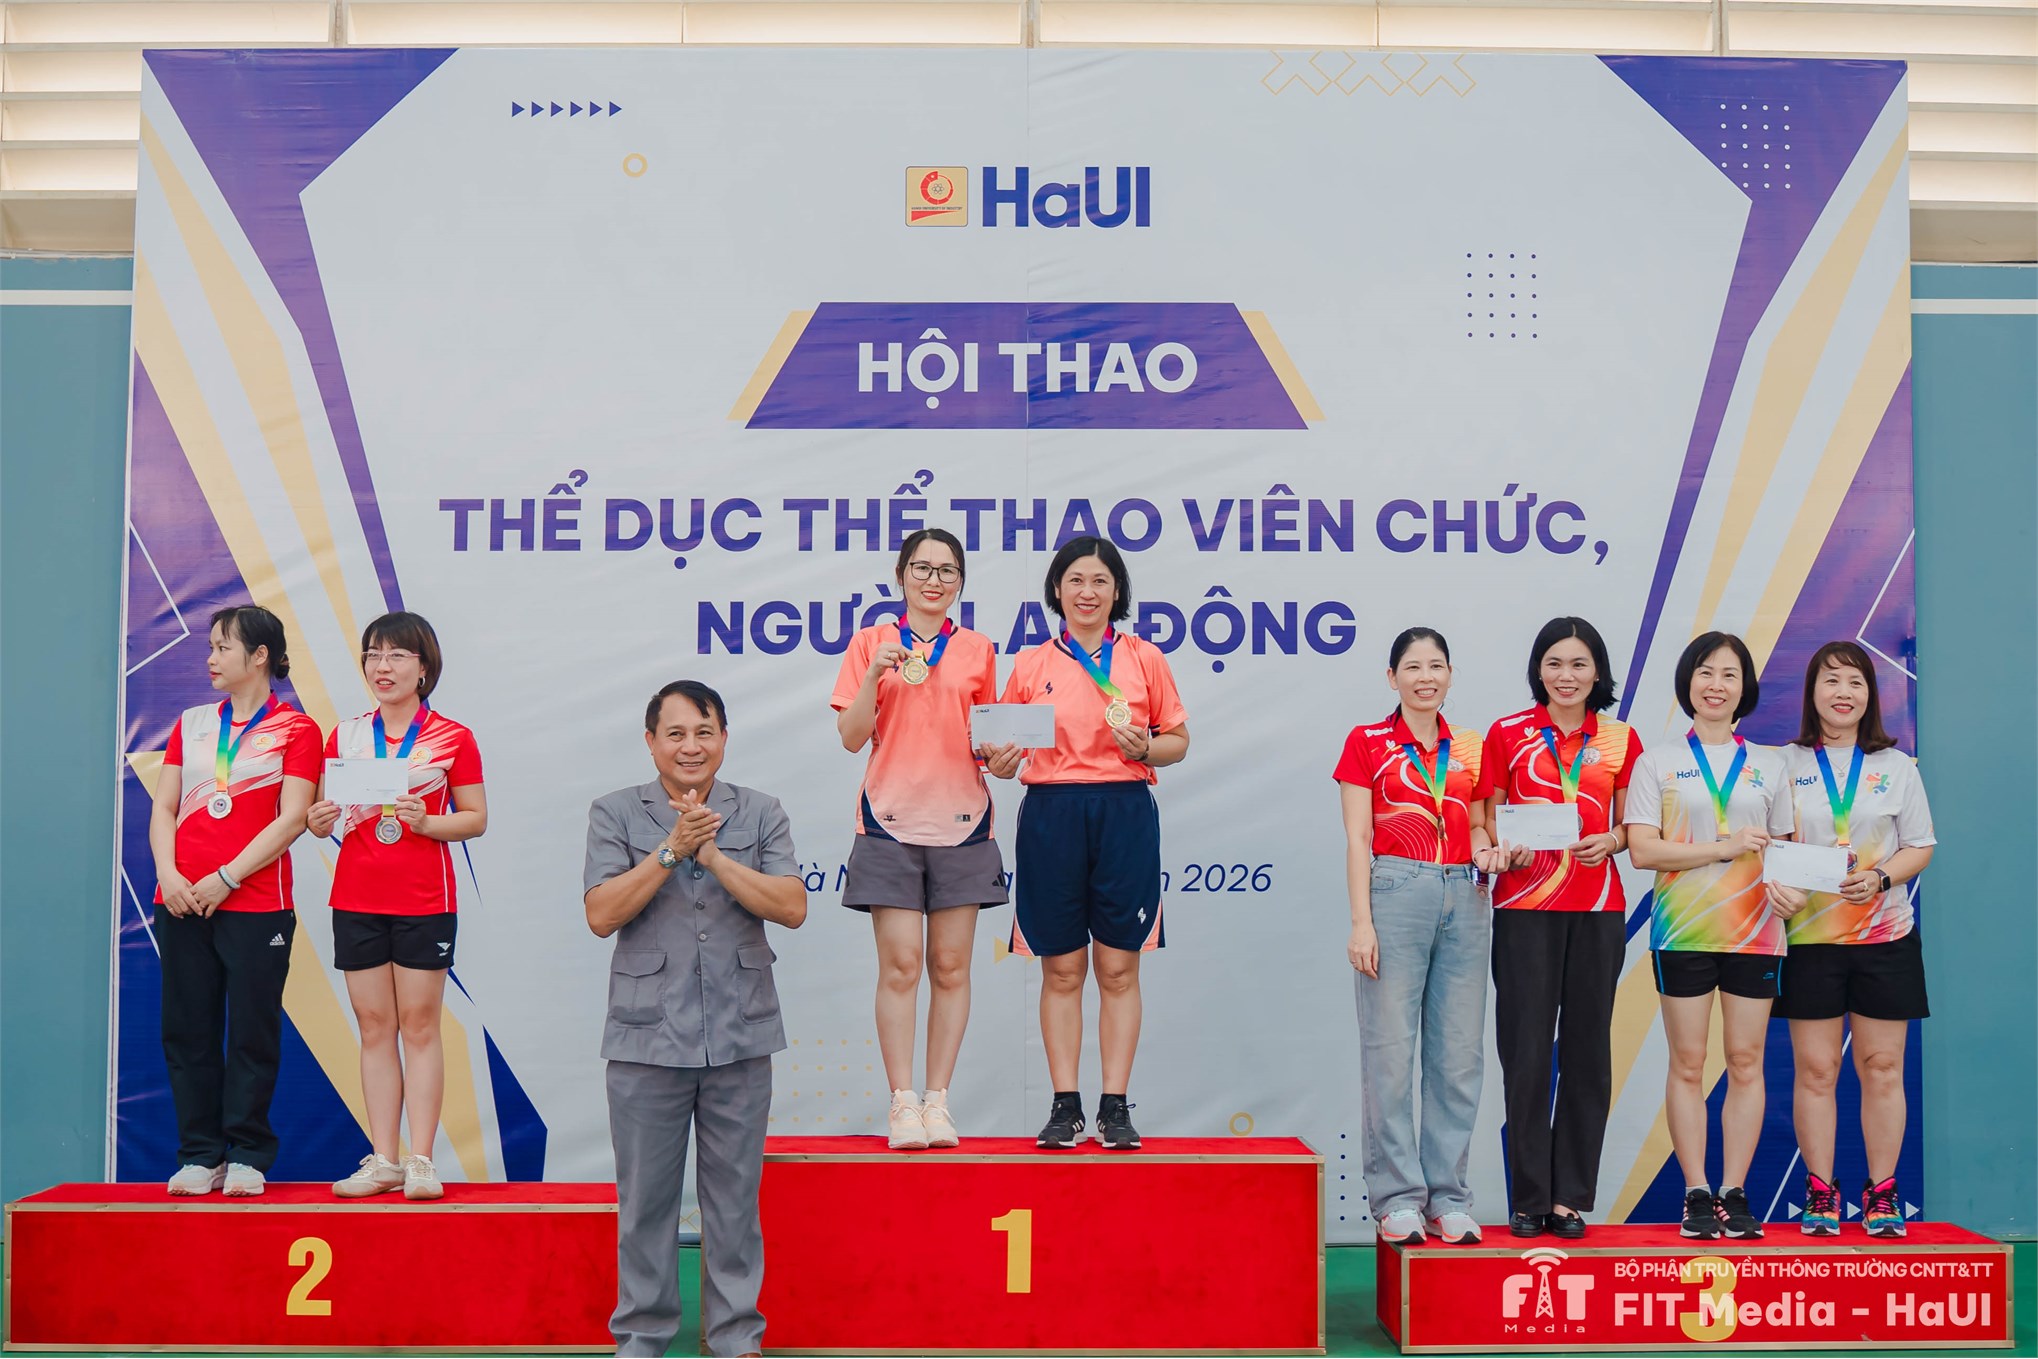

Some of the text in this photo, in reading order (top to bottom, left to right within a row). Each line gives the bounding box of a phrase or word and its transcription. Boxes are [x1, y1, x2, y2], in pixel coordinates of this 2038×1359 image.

[982, 166, 1151, 228] HaUI
[858, 327, 1198, 409] HỘI THAO
[439, 469, 1610, 570] THỂ DỤC THỂ THAO VIÊN CHỨC,
[961, 601, 1068, 655] LA
[1133, 585, 1357, 674] ĐỘNG
[1181, 863, 1273, 893] 2026
[286, 1236, 333, 1316] 2
[991, 1209, 1032, 1294] 1
[1679, 1256, 1738, 1343] 3
